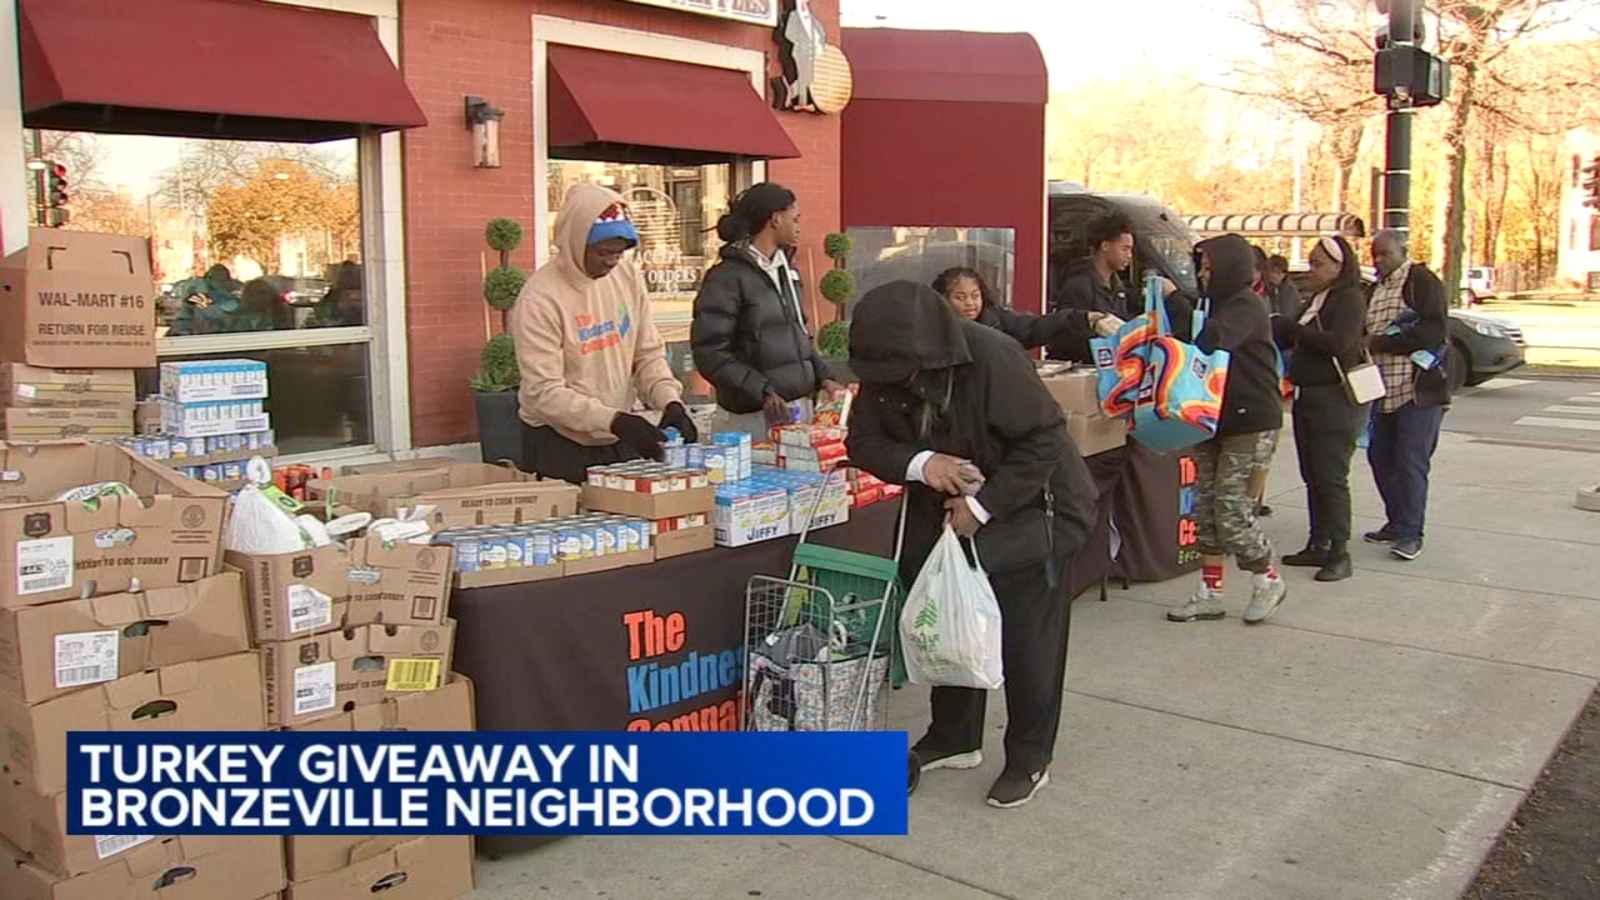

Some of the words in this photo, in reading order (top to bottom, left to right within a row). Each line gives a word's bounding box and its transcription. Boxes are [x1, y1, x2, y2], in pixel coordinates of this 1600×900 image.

[648, 269, 697, 284] ORDERS
[38, 291, 118, 308] WAL-MART
[120, 295, 145, 309] #16
[38, 323, 85, 336] RETURN
[87, 323, 110, 336] FOR
[111, 324, 146, 336] REUSE
[746, 526, 778, 541] JIFFY
[624, 610, 685, 660] The
[627, 644, 746, 714] Kindne
